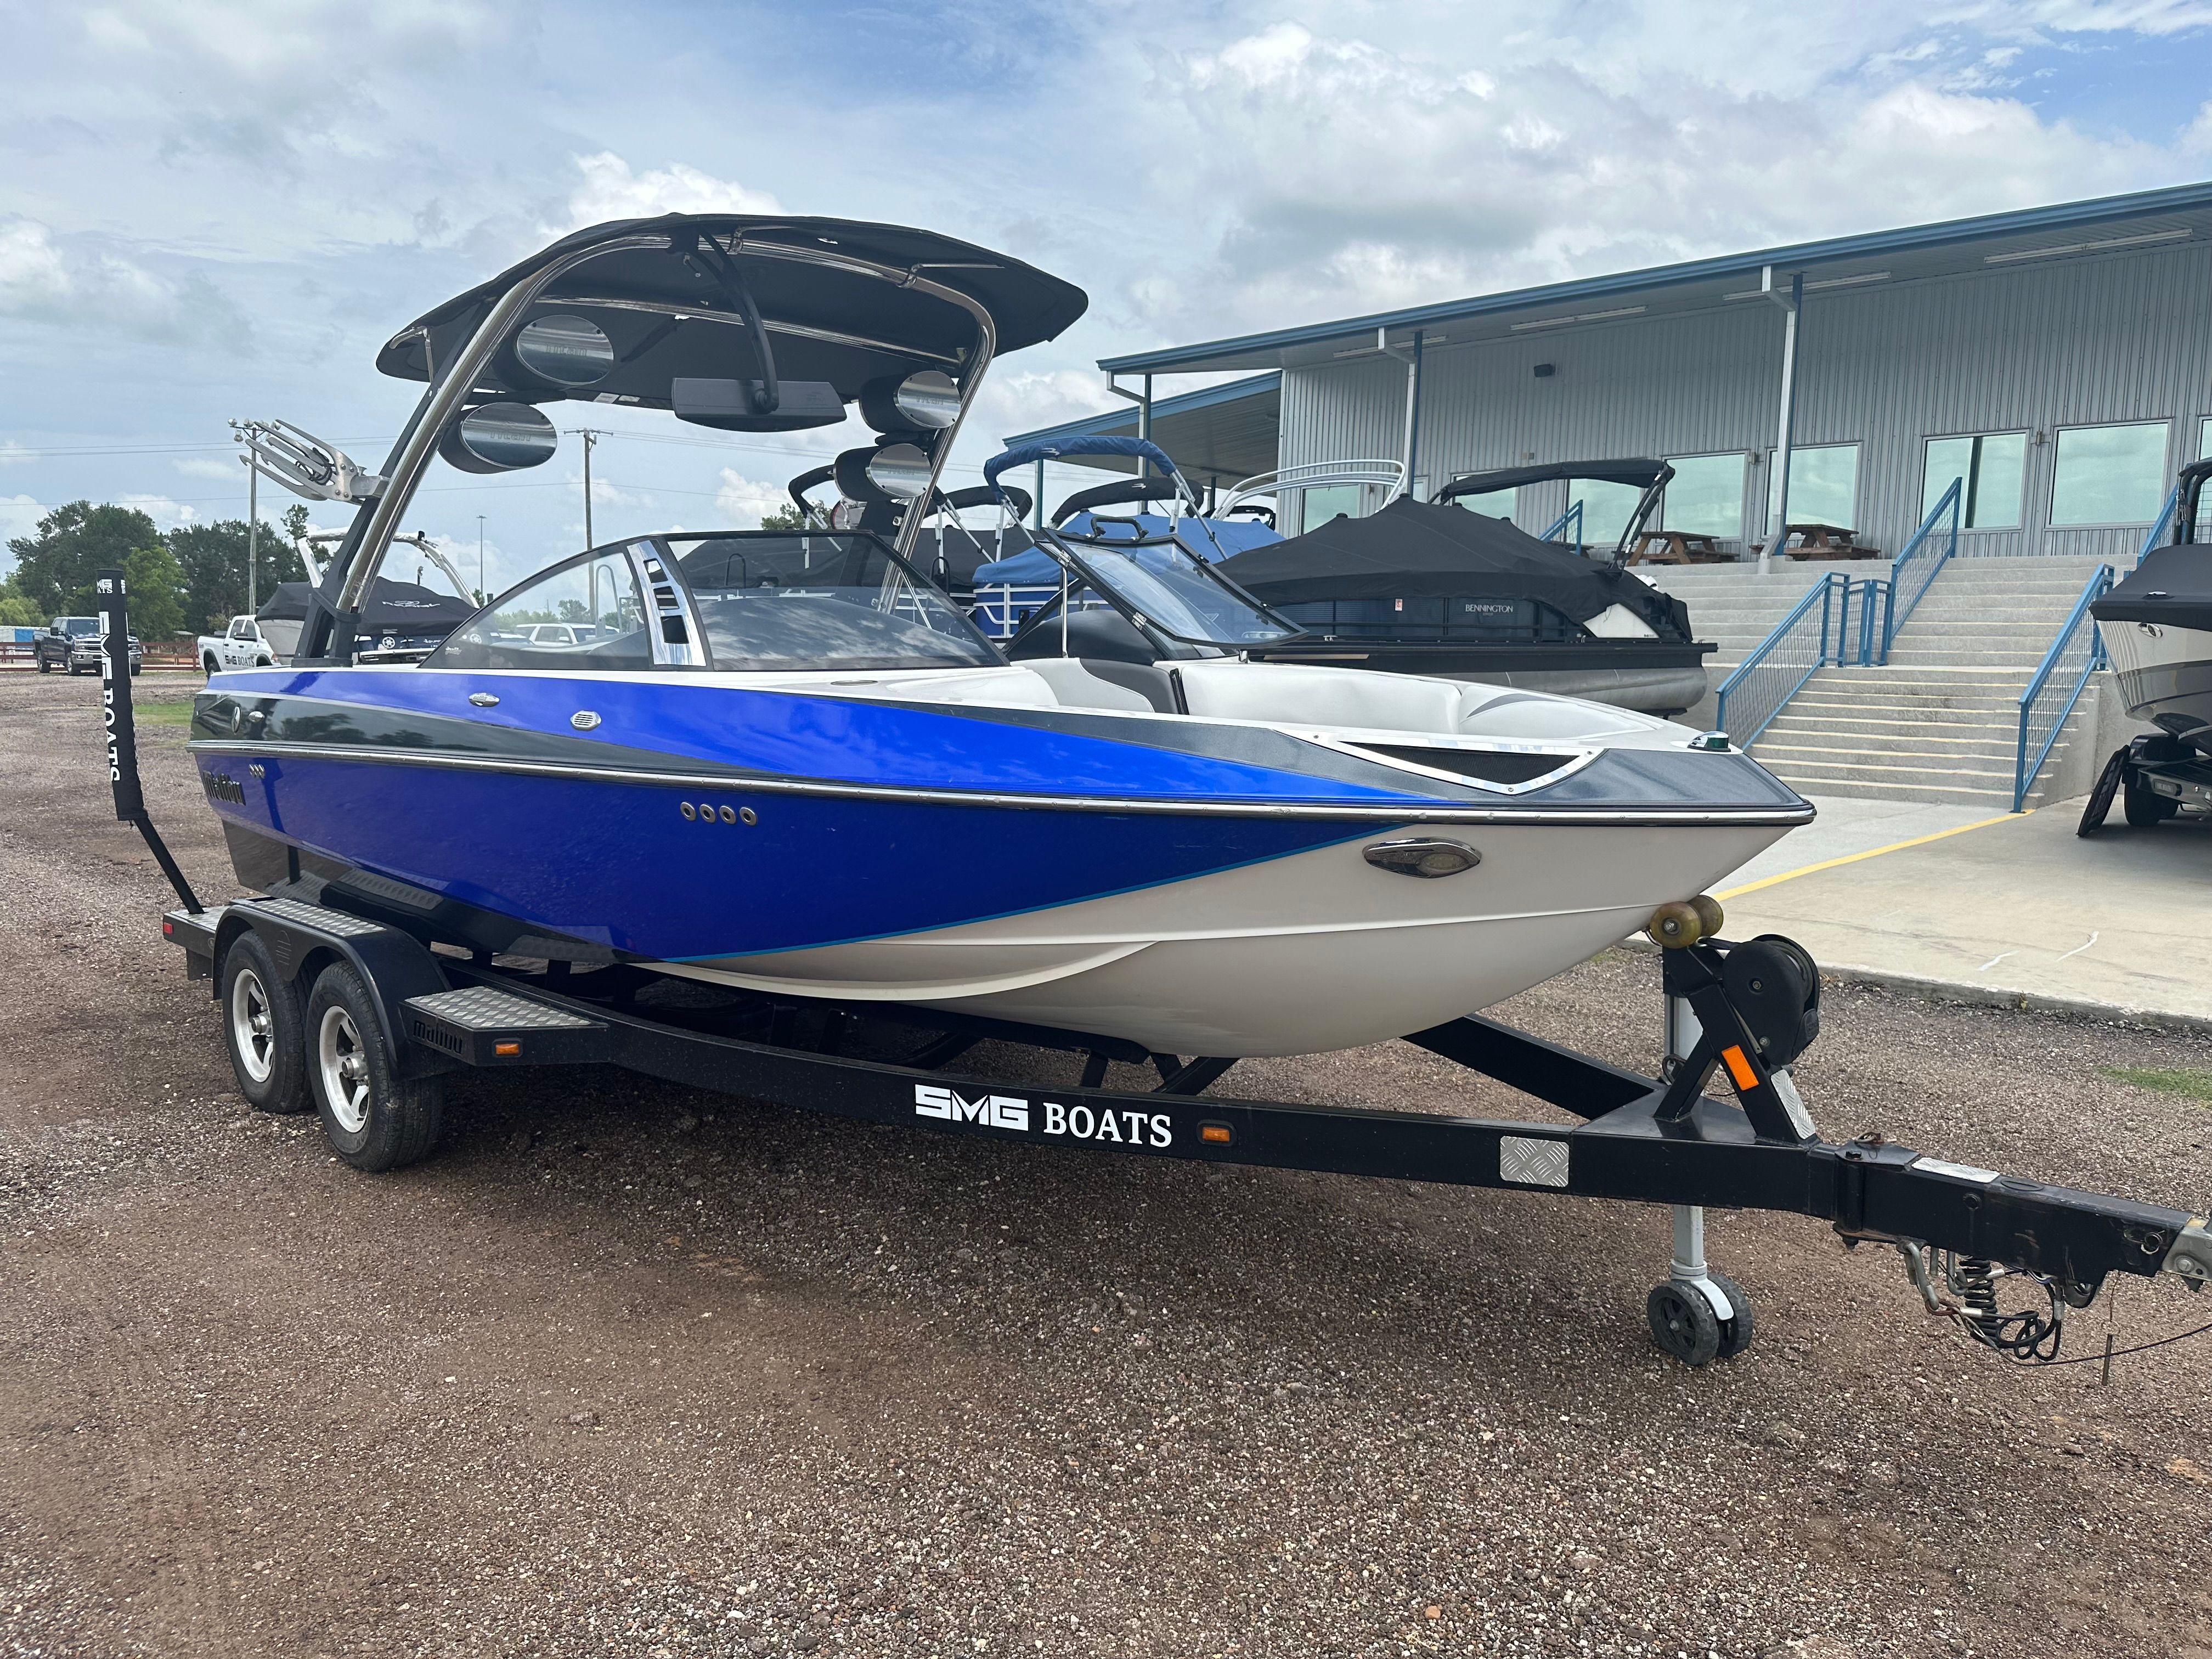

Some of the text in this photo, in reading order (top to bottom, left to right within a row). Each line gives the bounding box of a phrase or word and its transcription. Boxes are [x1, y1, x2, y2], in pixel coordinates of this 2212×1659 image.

[1465, 604, 1513, 613] BENNINGTON
[238, 656, 255, 668] BOATS
[915, 1084, 1172, 1148] SMG BOATS
